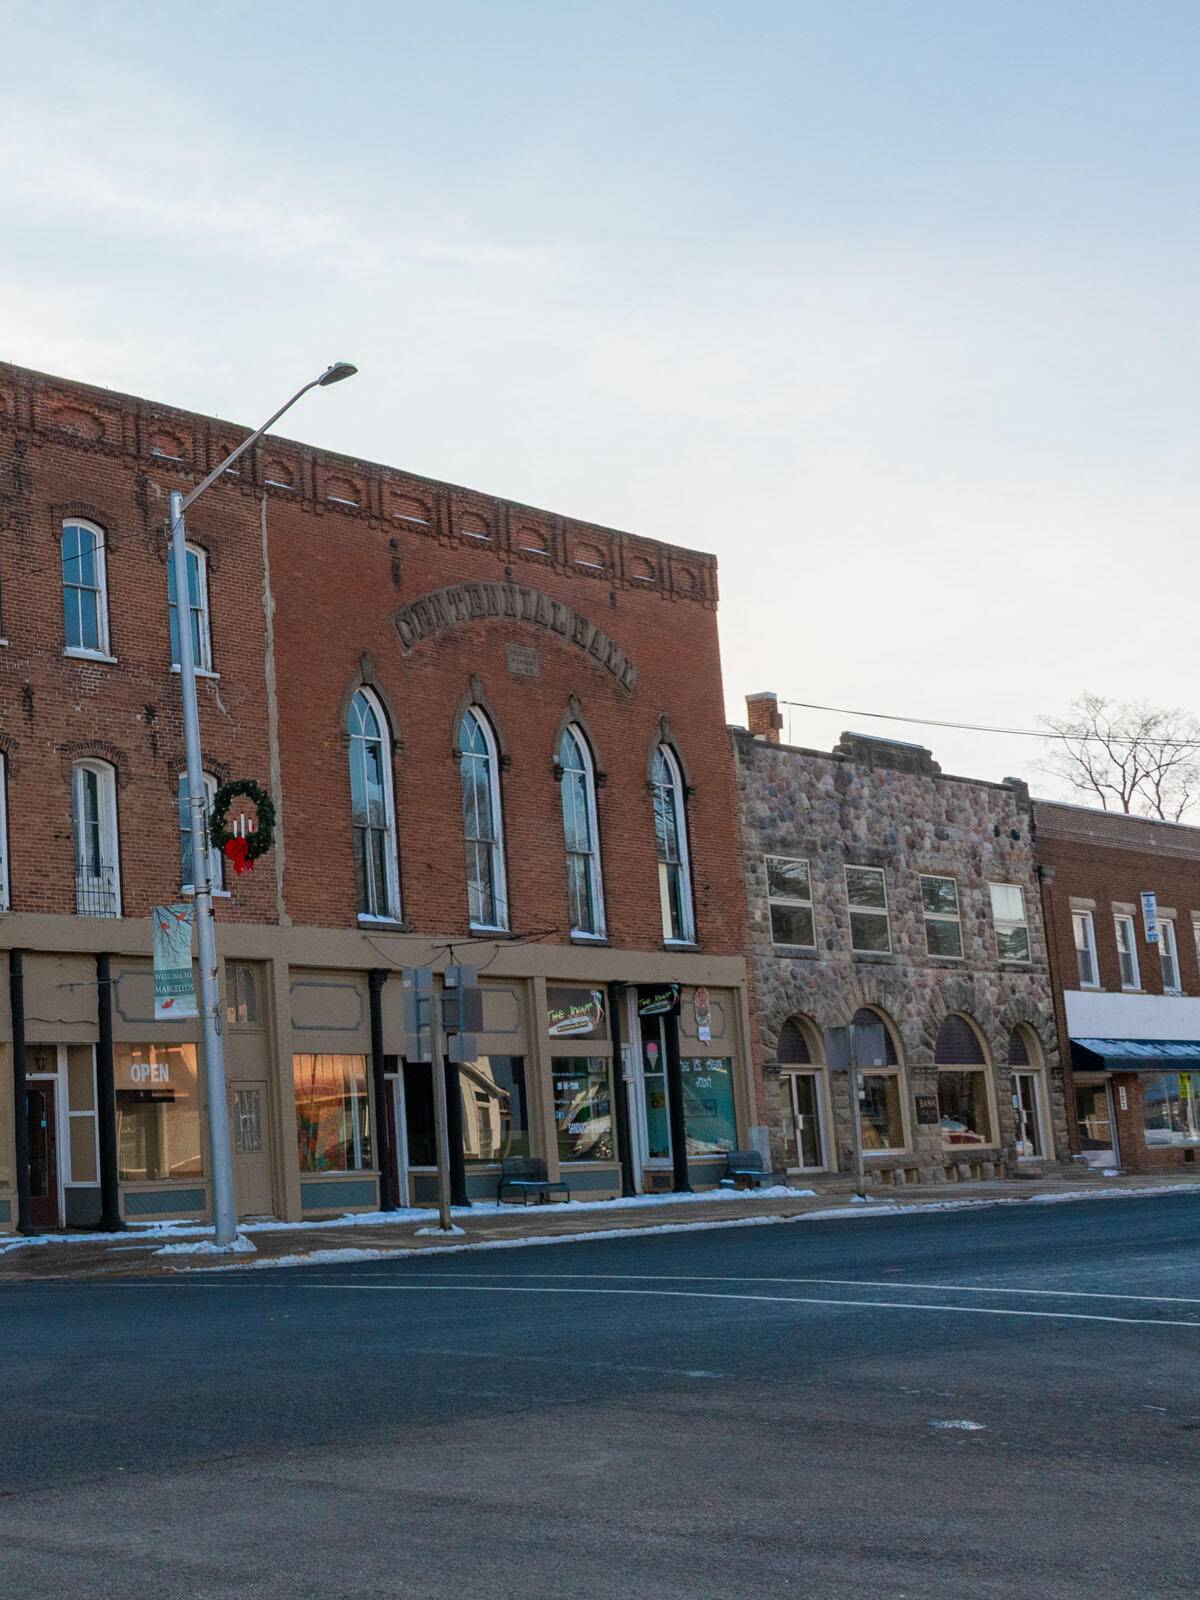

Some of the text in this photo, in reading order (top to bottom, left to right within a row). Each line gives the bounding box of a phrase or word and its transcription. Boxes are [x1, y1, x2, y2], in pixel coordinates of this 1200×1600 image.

[395, 582, 569, 648] CENTENNIAL
[154, 972, 183, 980] WELCOME
[155, 983, 195, 993] MARCELLUS
[130, 1063, 170, 1083] OPEN
